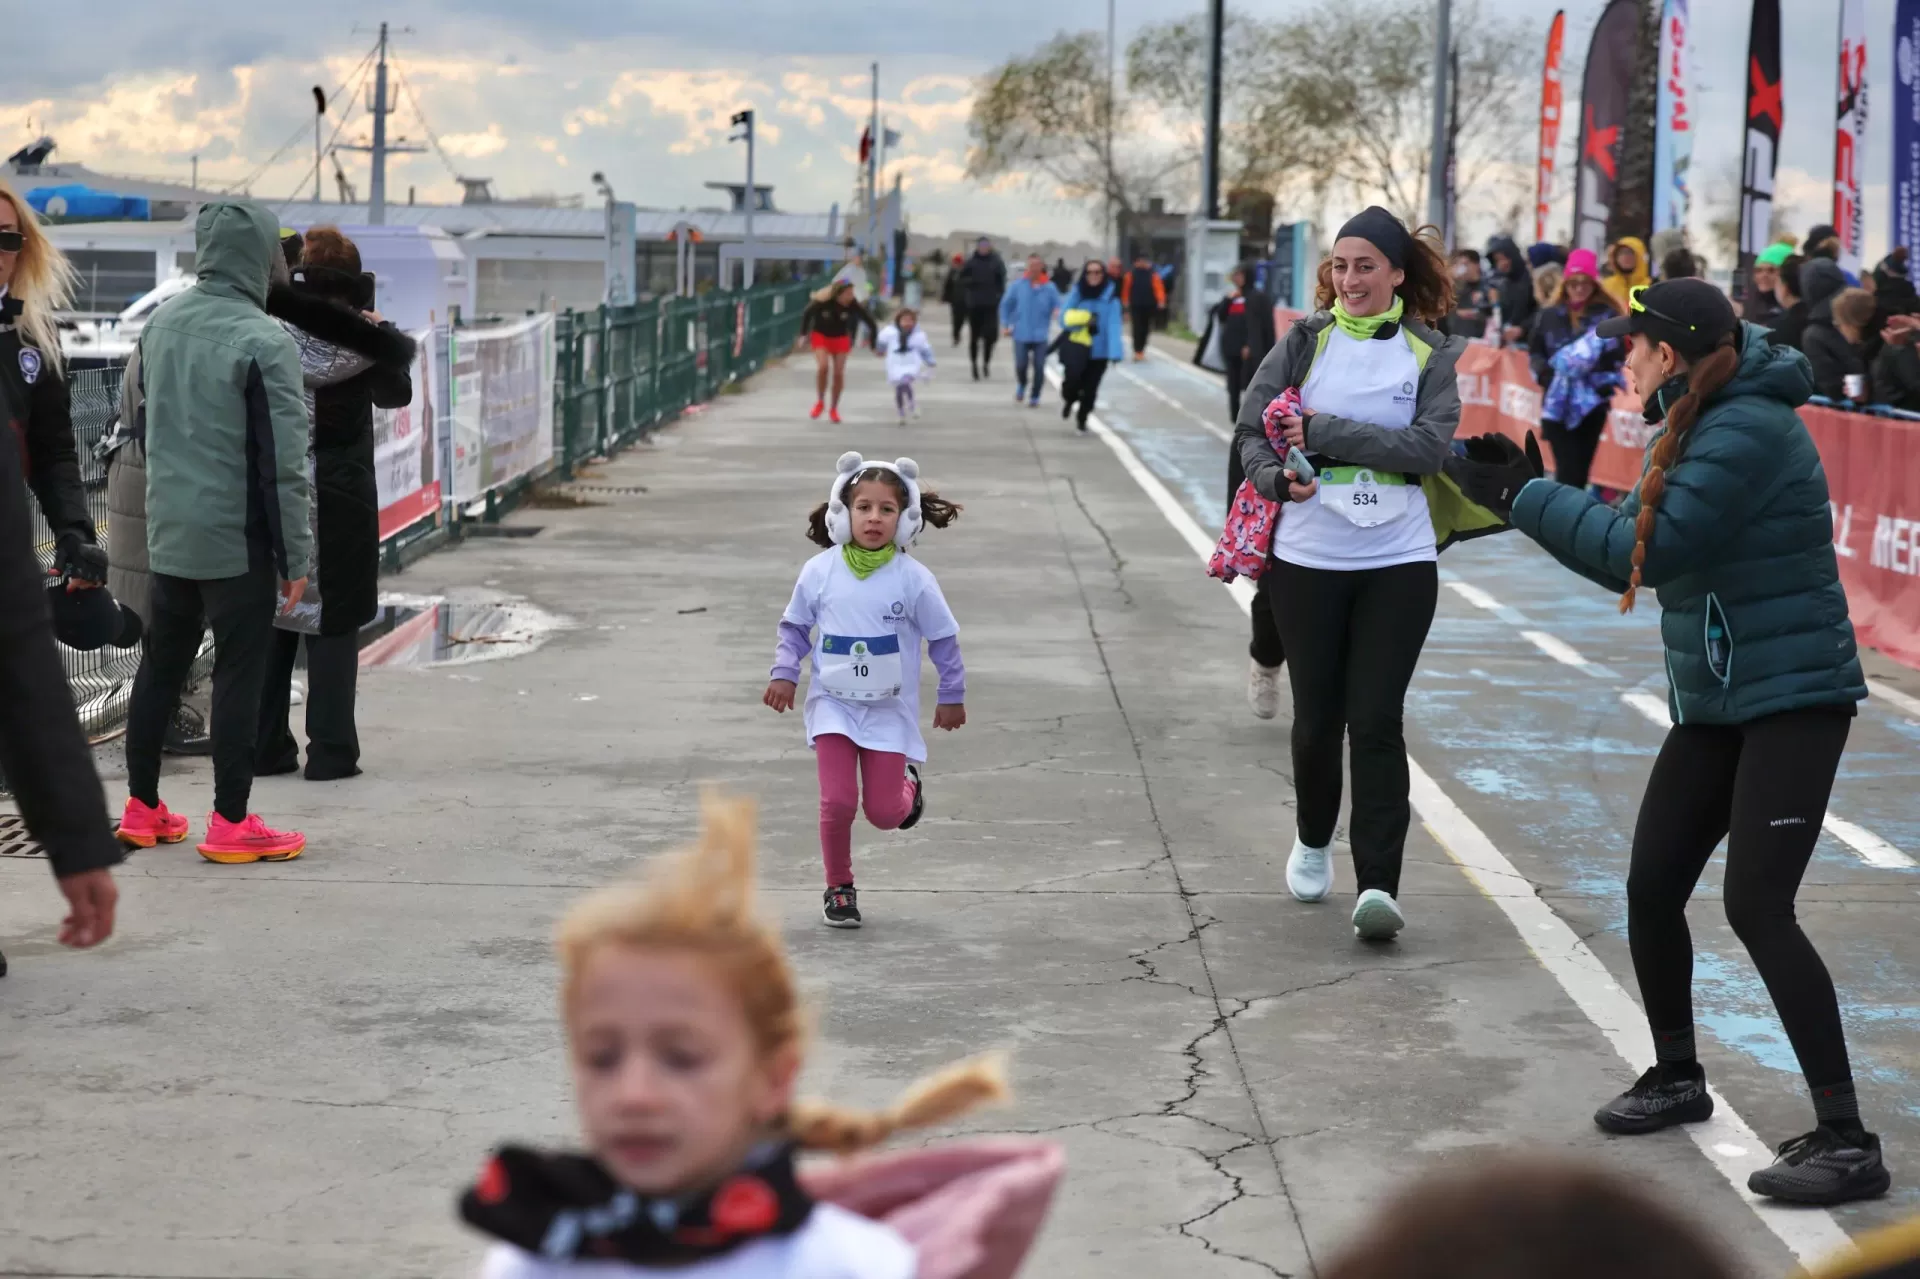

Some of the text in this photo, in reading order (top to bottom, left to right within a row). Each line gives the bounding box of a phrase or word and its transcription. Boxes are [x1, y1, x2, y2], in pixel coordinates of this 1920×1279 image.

[1353, 493, 1378, 505] 534
[853, 665, 868, 677] 10
[1770, 817, 1806, 827] MERRELL
